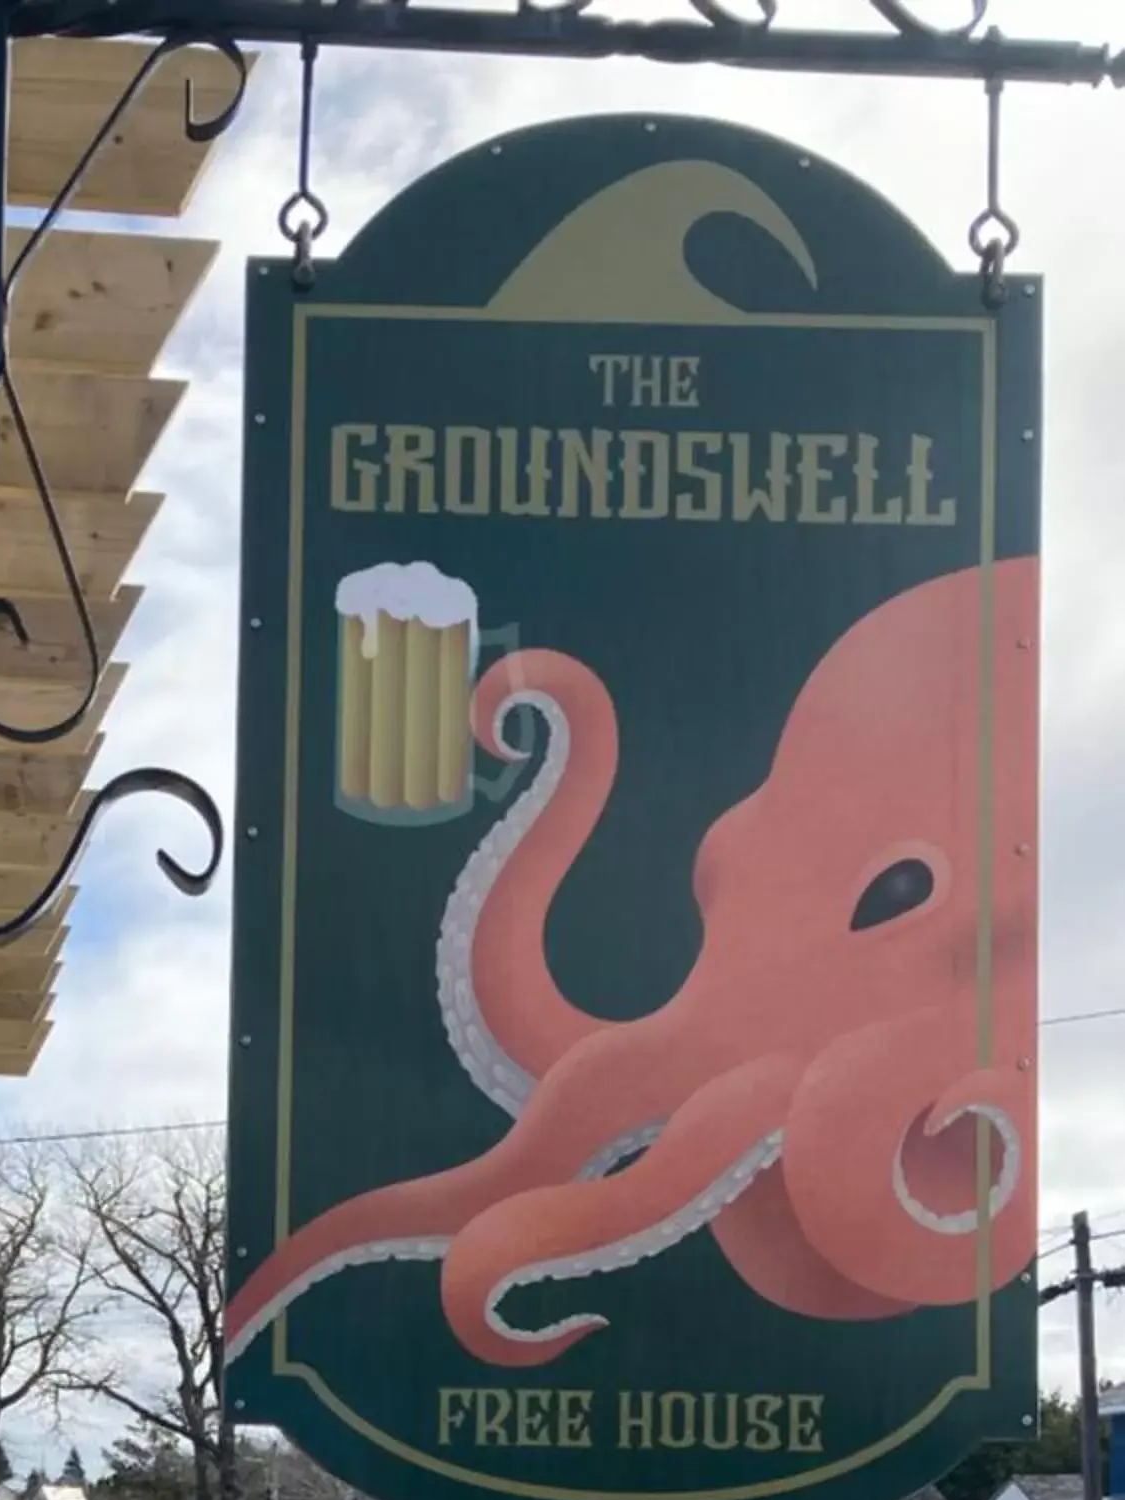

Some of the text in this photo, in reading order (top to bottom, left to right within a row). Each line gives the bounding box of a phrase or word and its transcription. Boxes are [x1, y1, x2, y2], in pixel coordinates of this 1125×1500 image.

[589, 354, 701, 407] THE
[330, 423, 957, 527] GROUNDSWELL
[438, 1387, 825, 1453] FREE HOUSE
